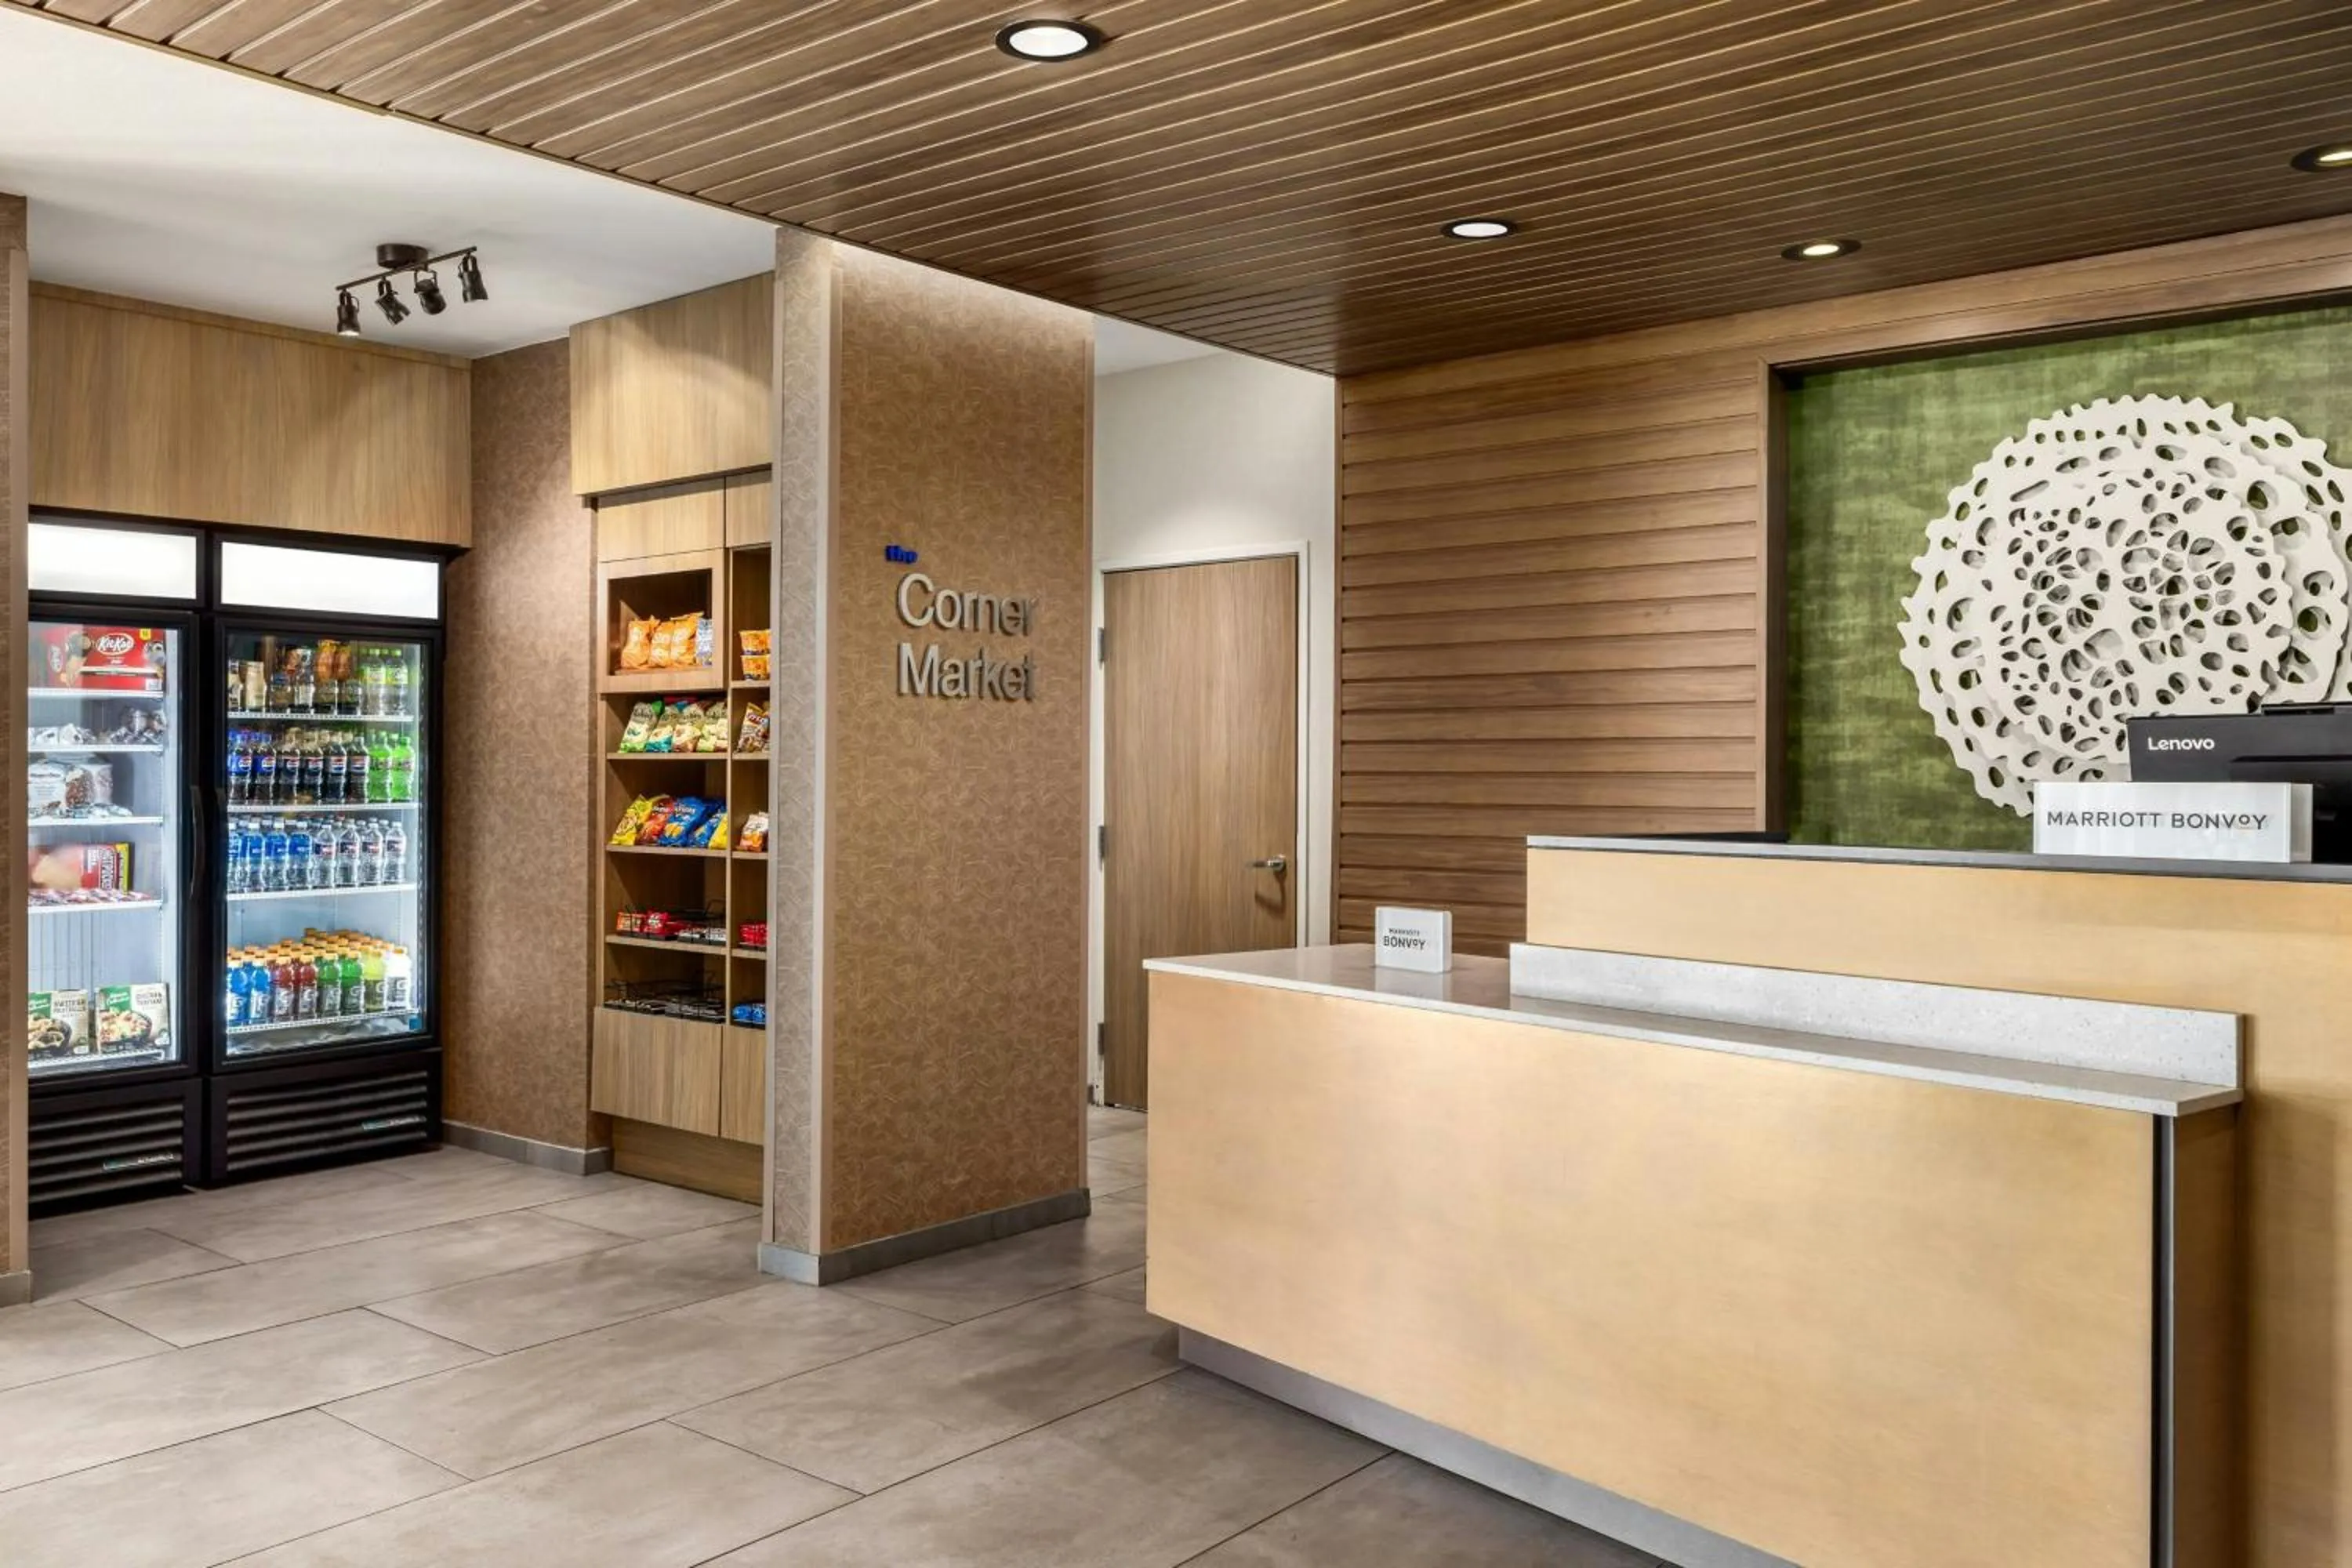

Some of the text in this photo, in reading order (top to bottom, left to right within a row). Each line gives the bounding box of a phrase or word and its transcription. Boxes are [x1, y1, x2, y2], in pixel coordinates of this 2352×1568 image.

[898, 573, 1038, 636] Corner
[898, 642, 1036, 702] Market
[2147, 737, 2216, 751] Lenovo
[2046, 811, 2267, 830] MARRIOTT BONVOY
[1383, 935, 1426, 950] BONVOY
